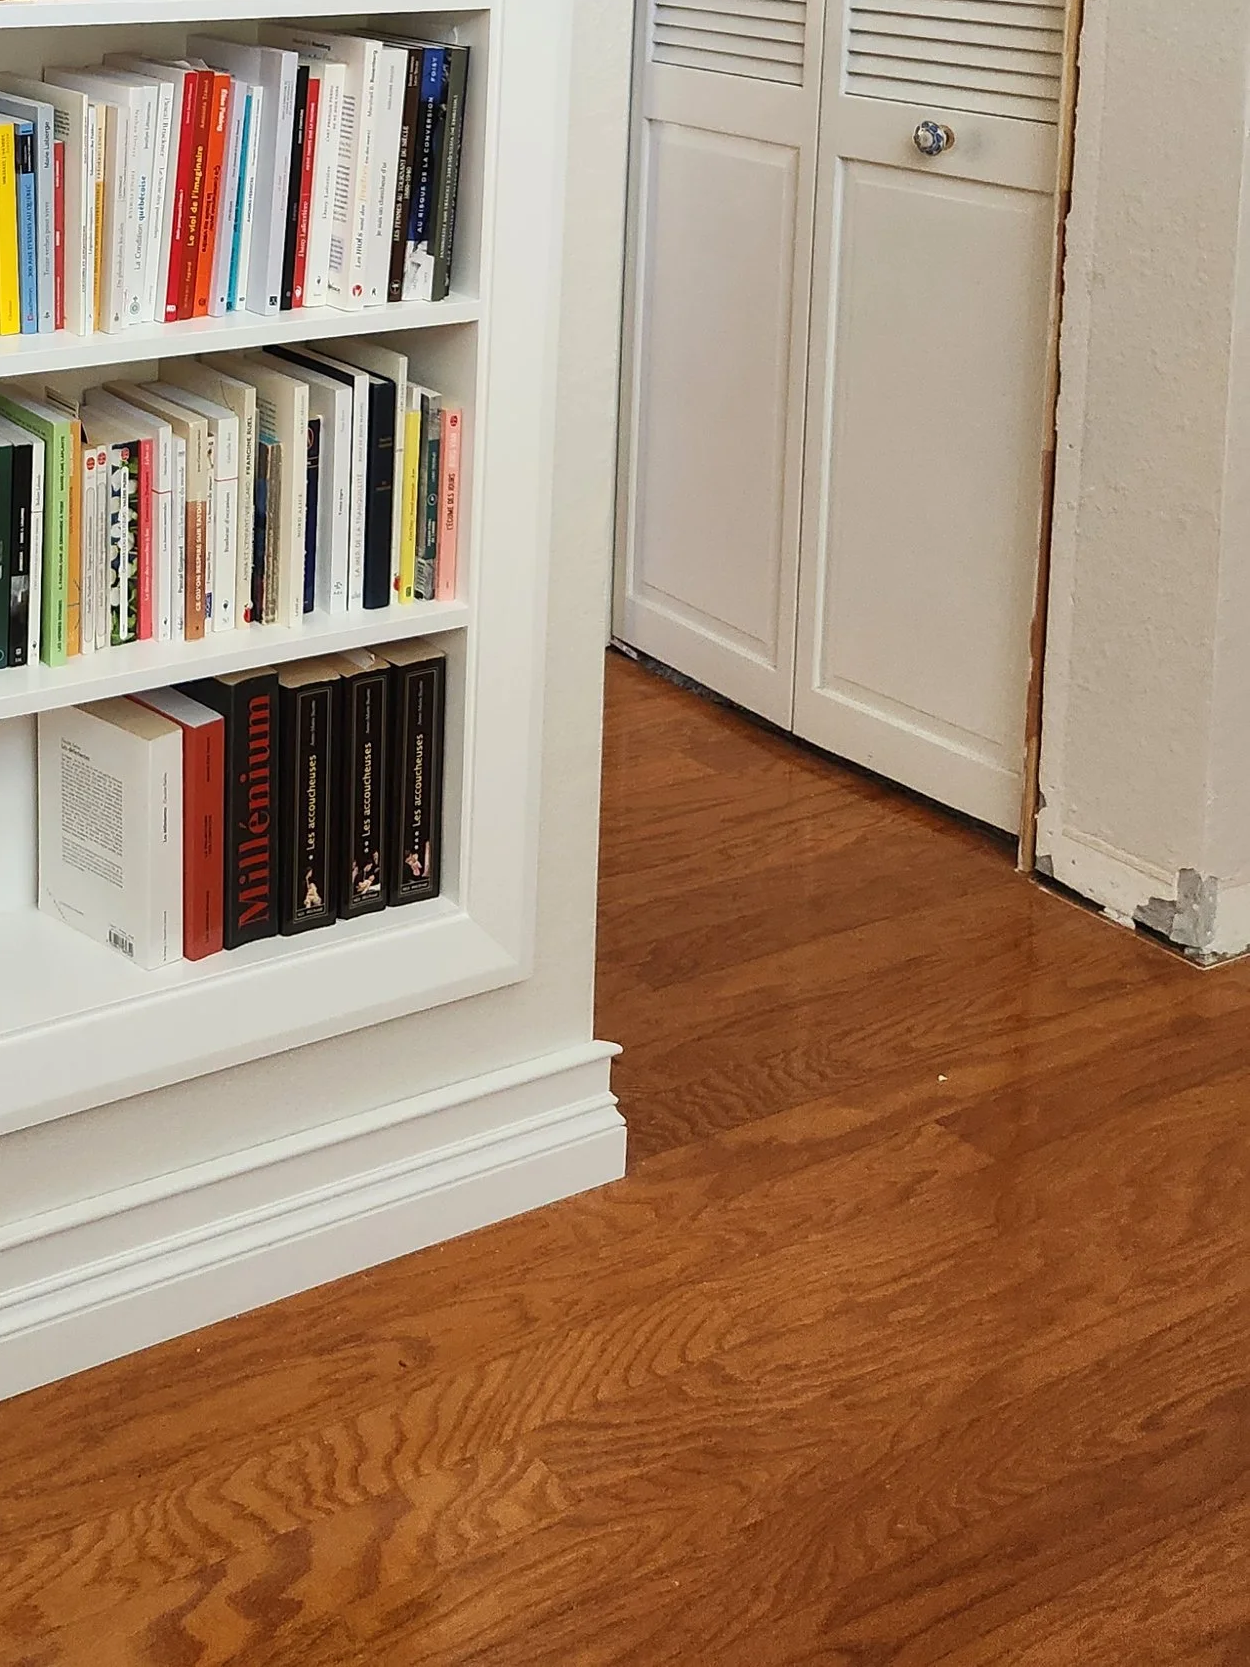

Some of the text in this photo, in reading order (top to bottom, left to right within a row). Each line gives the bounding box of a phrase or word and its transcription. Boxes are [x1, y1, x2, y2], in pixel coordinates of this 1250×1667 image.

[429, 56, 438, 82] FOISY
[422, 96, 435, 154] CONVERSION
[43, 121, 51, 169] Marie Laberge
[189, 145, 204, 200] l'imaginaire
[419, 170, 428, 183] DE
[136, 175, 147, 222] québécoise
[190, 201, 199, 214] de
[417, 185, 427, 218] RISQUE
[188, 215, 198, 234] viol
[394, 204, 403, 229] FEMMES
[134, 223, 144, 260] Condition
[393, 229, 401, 242] LES
[244, 416, 253, 476] FRANCINE RUEL
[356, 473, 364, 525] TRANQUILLITÉ
[447, 473, 456, 492] JOURS
[446, 504, 455, 531] L'ÉCUME
[195, 528, 203, 543] SUR
[195, 543, 203, 574] RESPIRE
[354, 550, 362, 566] MER
[361, 742, 373, 837] Les accoucheuses
[412, 733, 425, 828] Les accoucheuses
[237, 693, 271, 931] Millénium
[305, 754, 318, 851] Les accoucheuses
